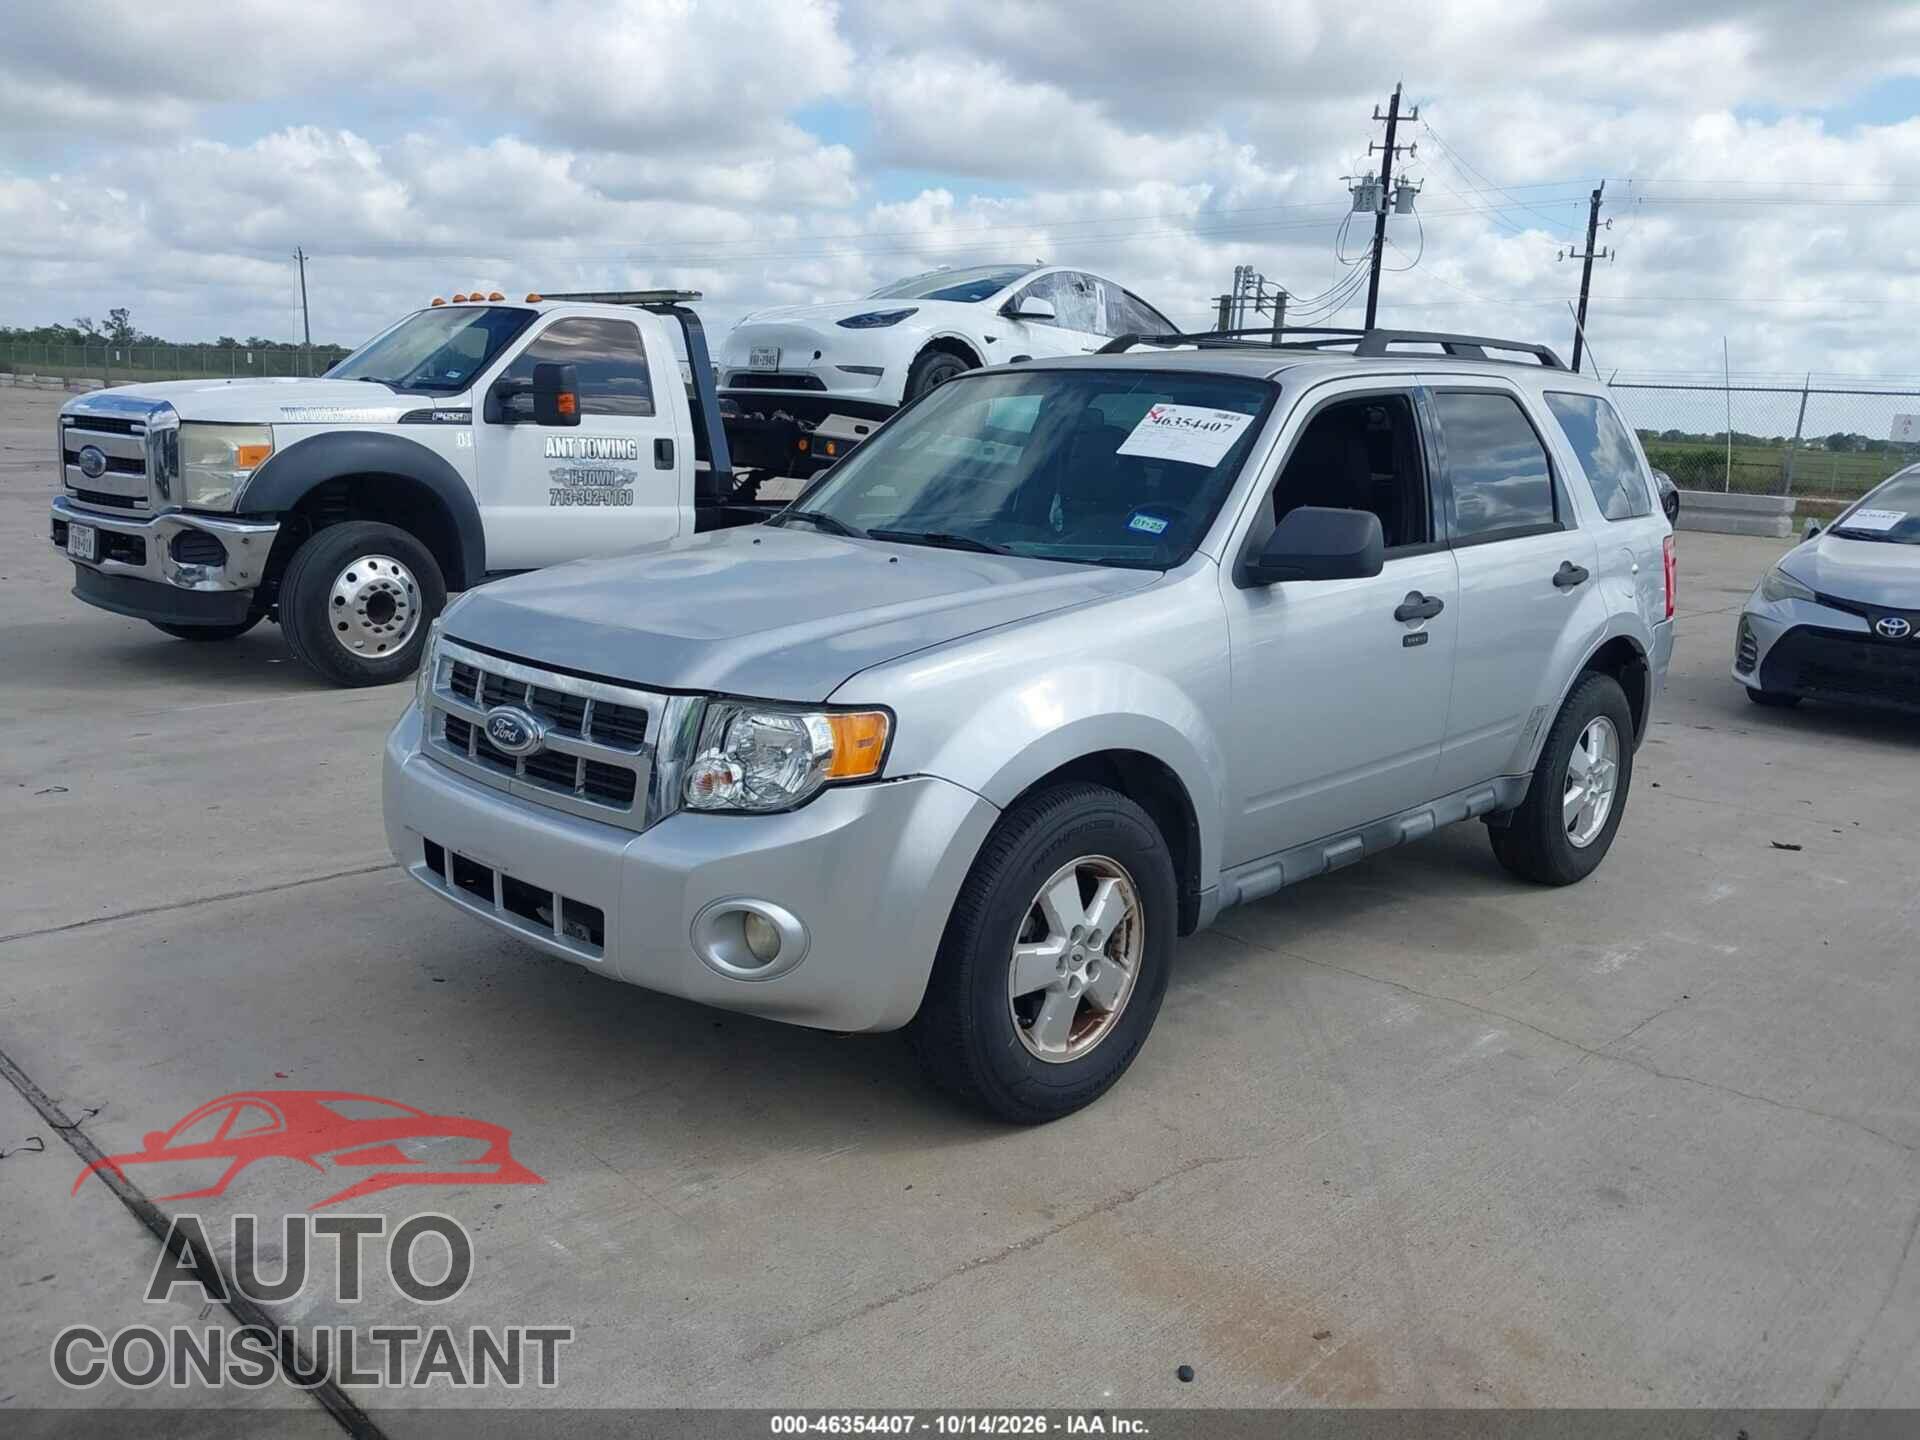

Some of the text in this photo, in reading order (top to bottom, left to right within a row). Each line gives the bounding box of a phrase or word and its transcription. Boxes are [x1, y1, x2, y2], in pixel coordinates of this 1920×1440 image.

[1152, 415, 1233, 433] 46354407
[544, 436, 638, 460] ANT TOWING
[569, 469, 616, 486] H-TOWN
[492, 718, 519, 742] Ford
